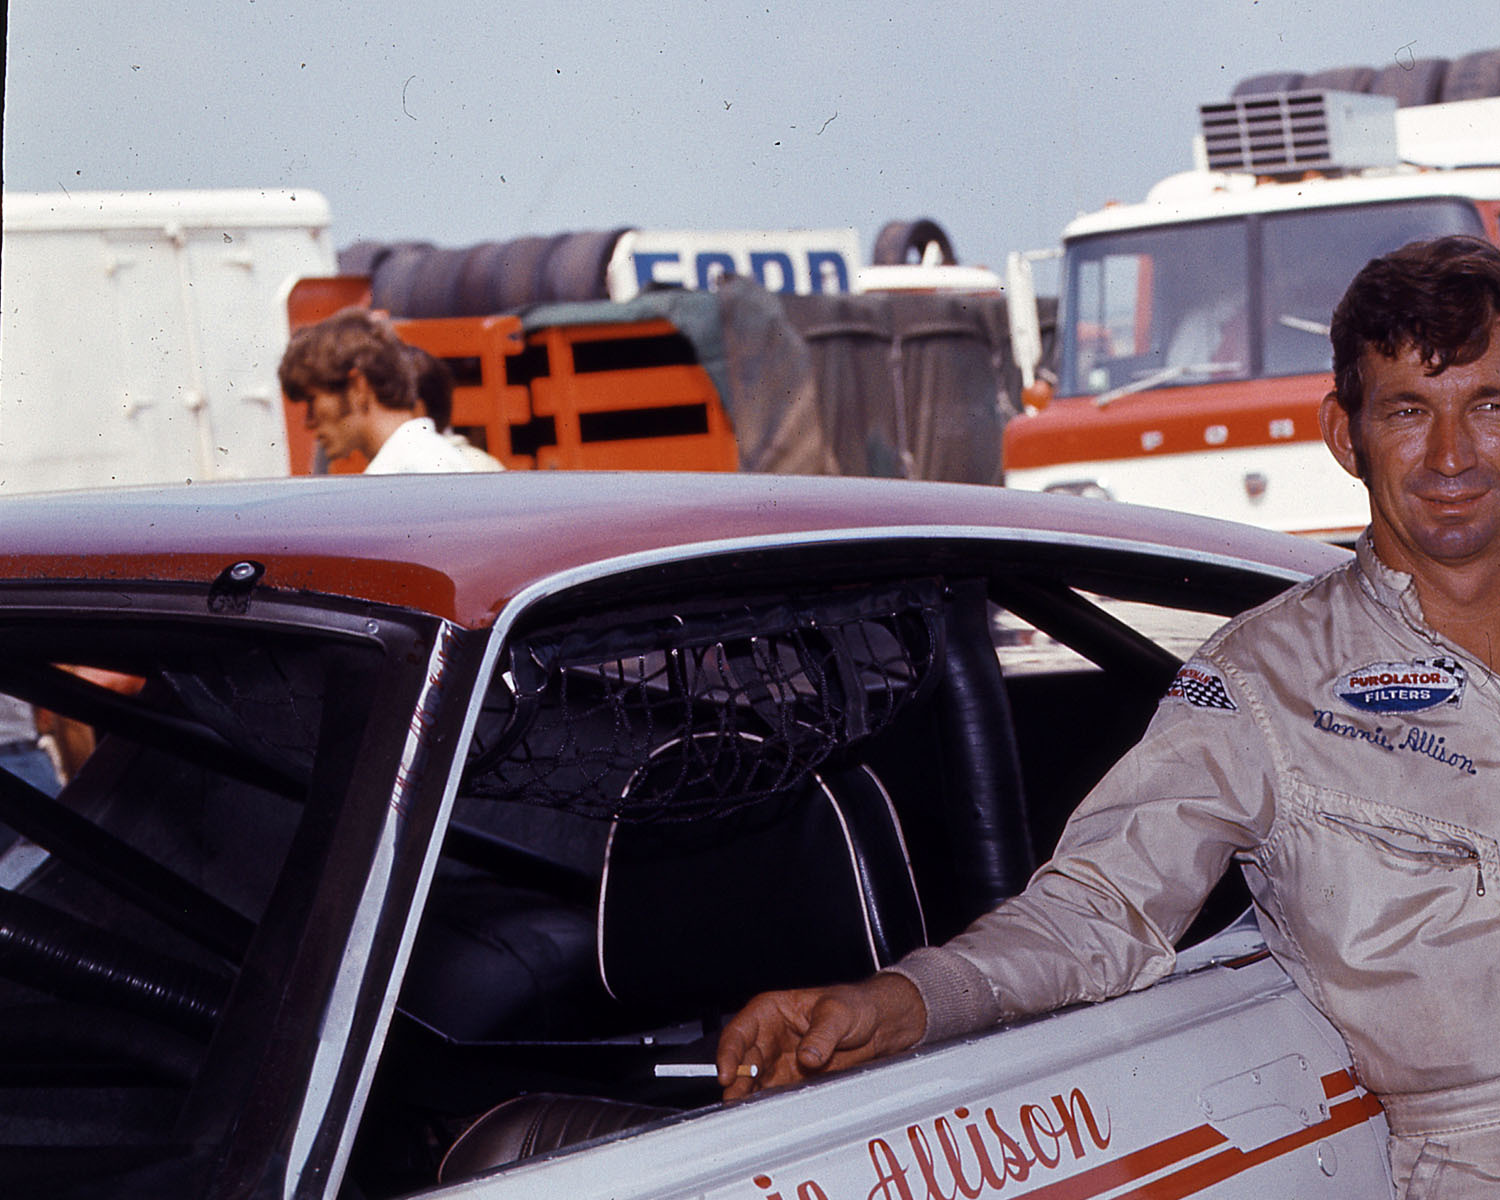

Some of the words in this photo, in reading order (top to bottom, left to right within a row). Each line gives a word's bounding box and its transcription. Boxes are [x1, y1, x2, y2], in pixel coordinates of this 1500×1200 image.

[1350, 672, 1441, 688] PUROLATOR
[1365, 690, 1431, 703] FILTERS
[1313, 710, 1394, 751] Donnie
[1399, 727, 1476, 775] Allison
